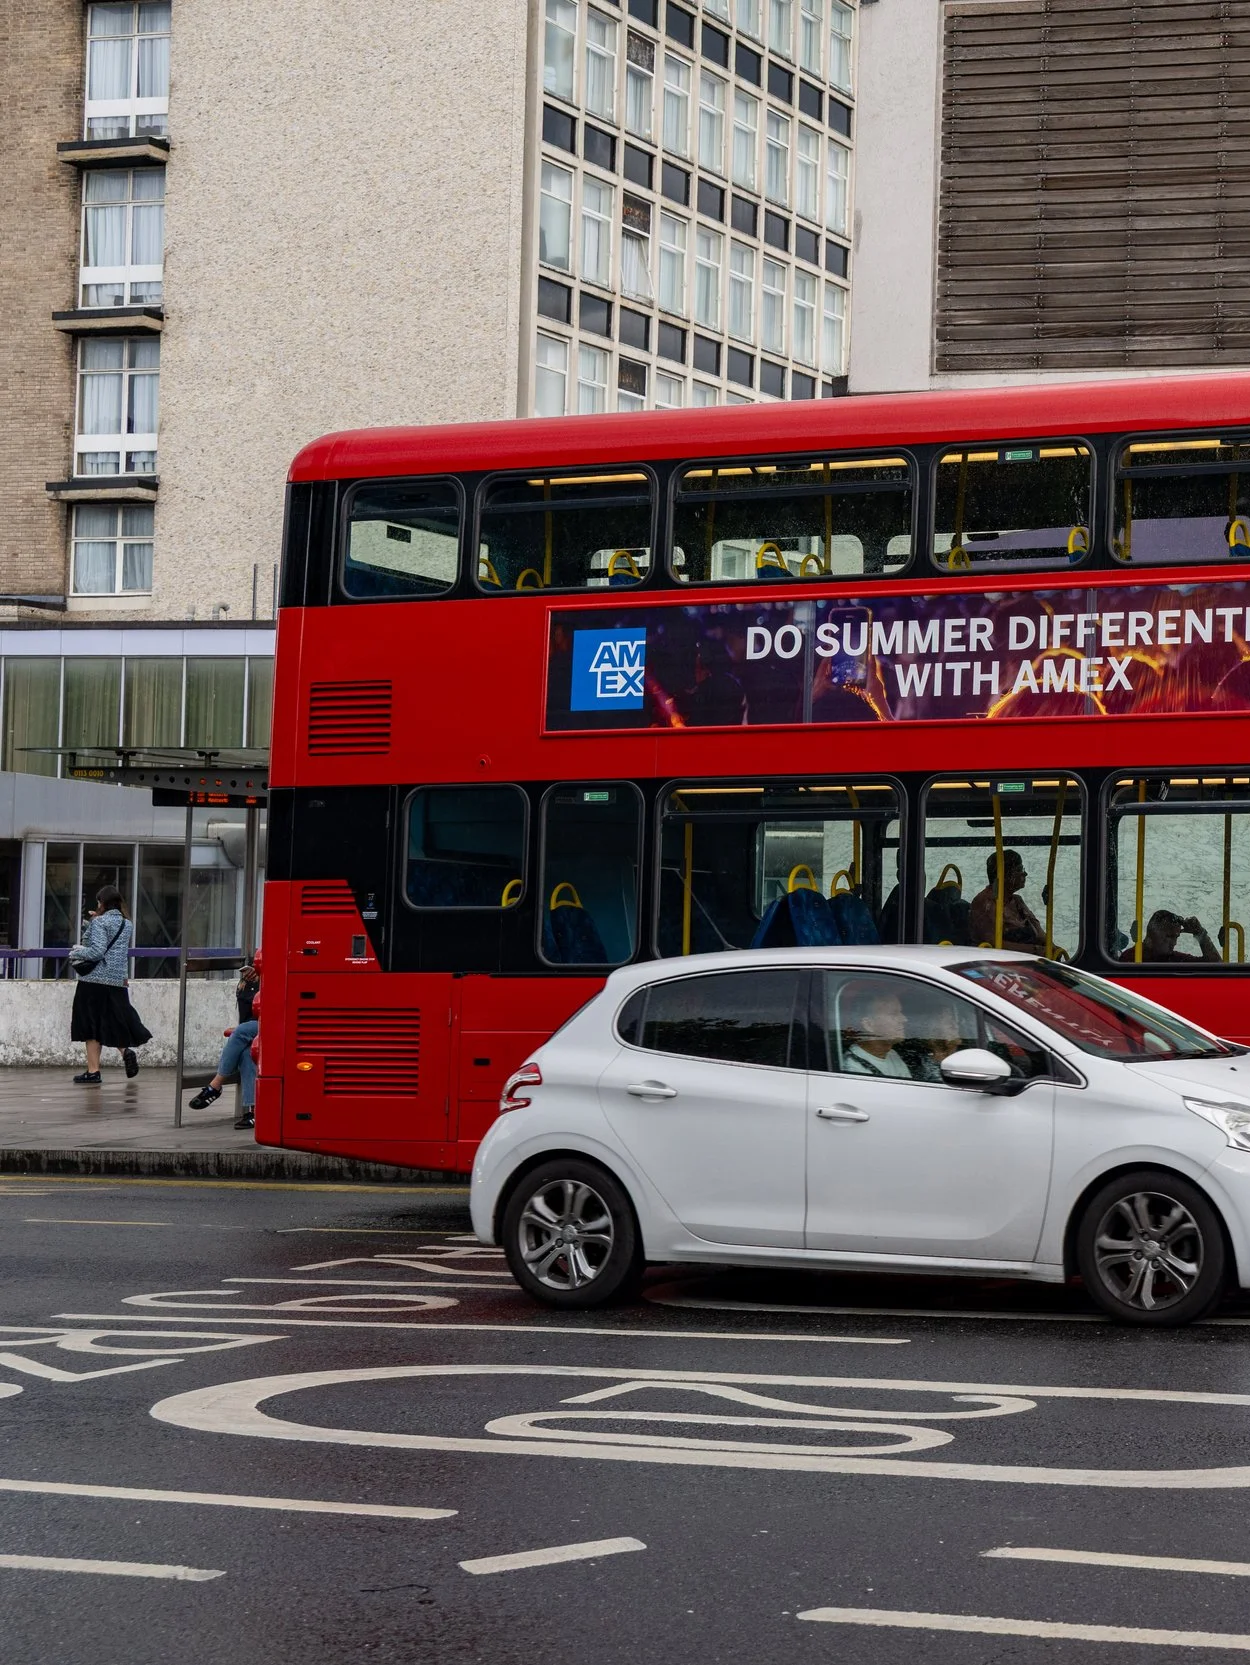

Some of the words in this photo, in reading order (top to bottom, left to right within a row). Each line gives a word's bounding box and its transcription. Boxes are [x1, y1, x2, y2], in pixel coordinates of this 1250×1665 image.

[746, 624, 803, 660] DO
[815, 618, 994, 657] SUMMER
[894, 660, 1000, 698] WITH
[1011, 656, 1133, 695] AMEX
[485, 1380, 1037, 1456] 20
